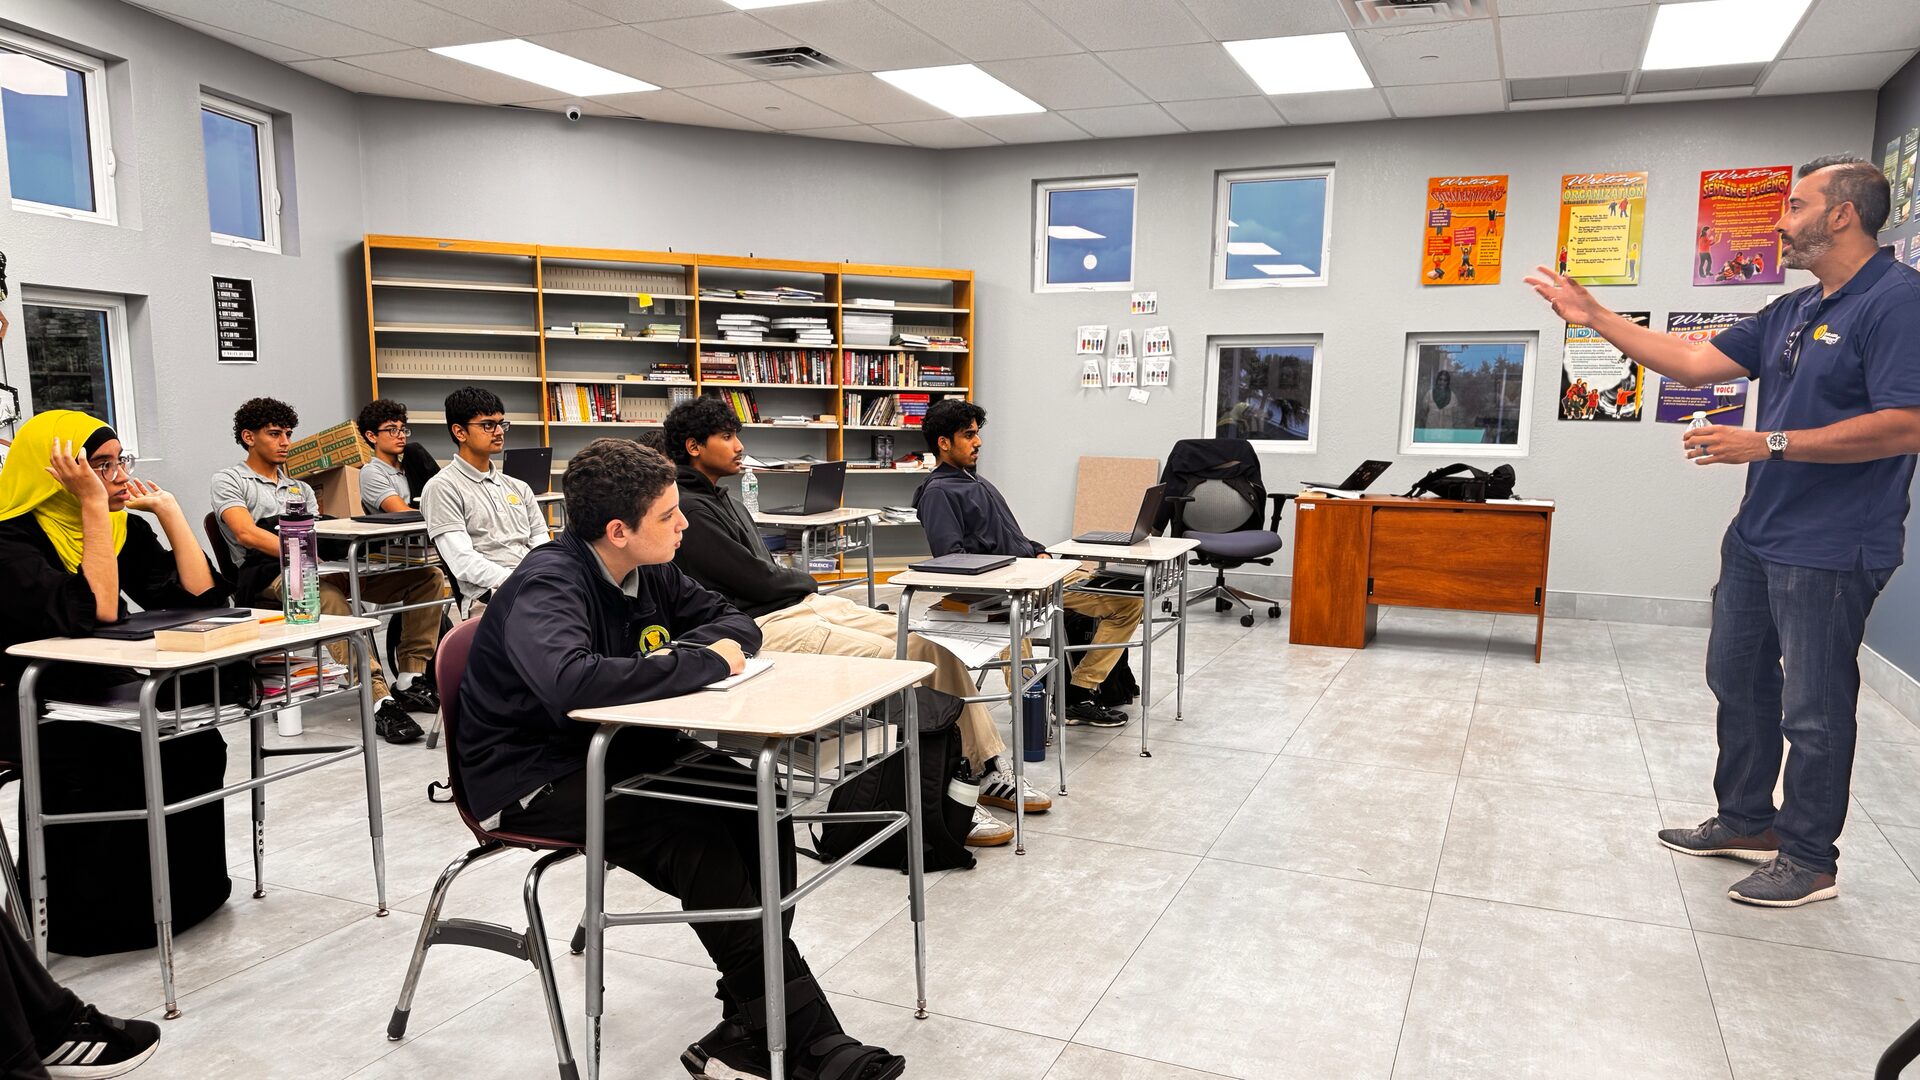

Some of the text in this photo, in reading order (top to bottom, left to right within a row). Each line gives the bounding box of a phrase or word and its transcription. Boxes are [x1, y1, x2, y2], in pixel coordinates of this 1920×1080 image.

[1565, 173, 1642, 186] Writing
[1704, 169, 1788, 181] Writing
[1438, 177, 1500, 187] Writing
[1703, 178, 1790, 199] SENTENCE FLUENCY
[1563, 186, 1644, 200] ORGANIZATION
[1715, 386, 1735, 394] VOICE
[324, 438, 355, 453] FILTERBUY
[291, 460, 319, 475] FILTERBU
